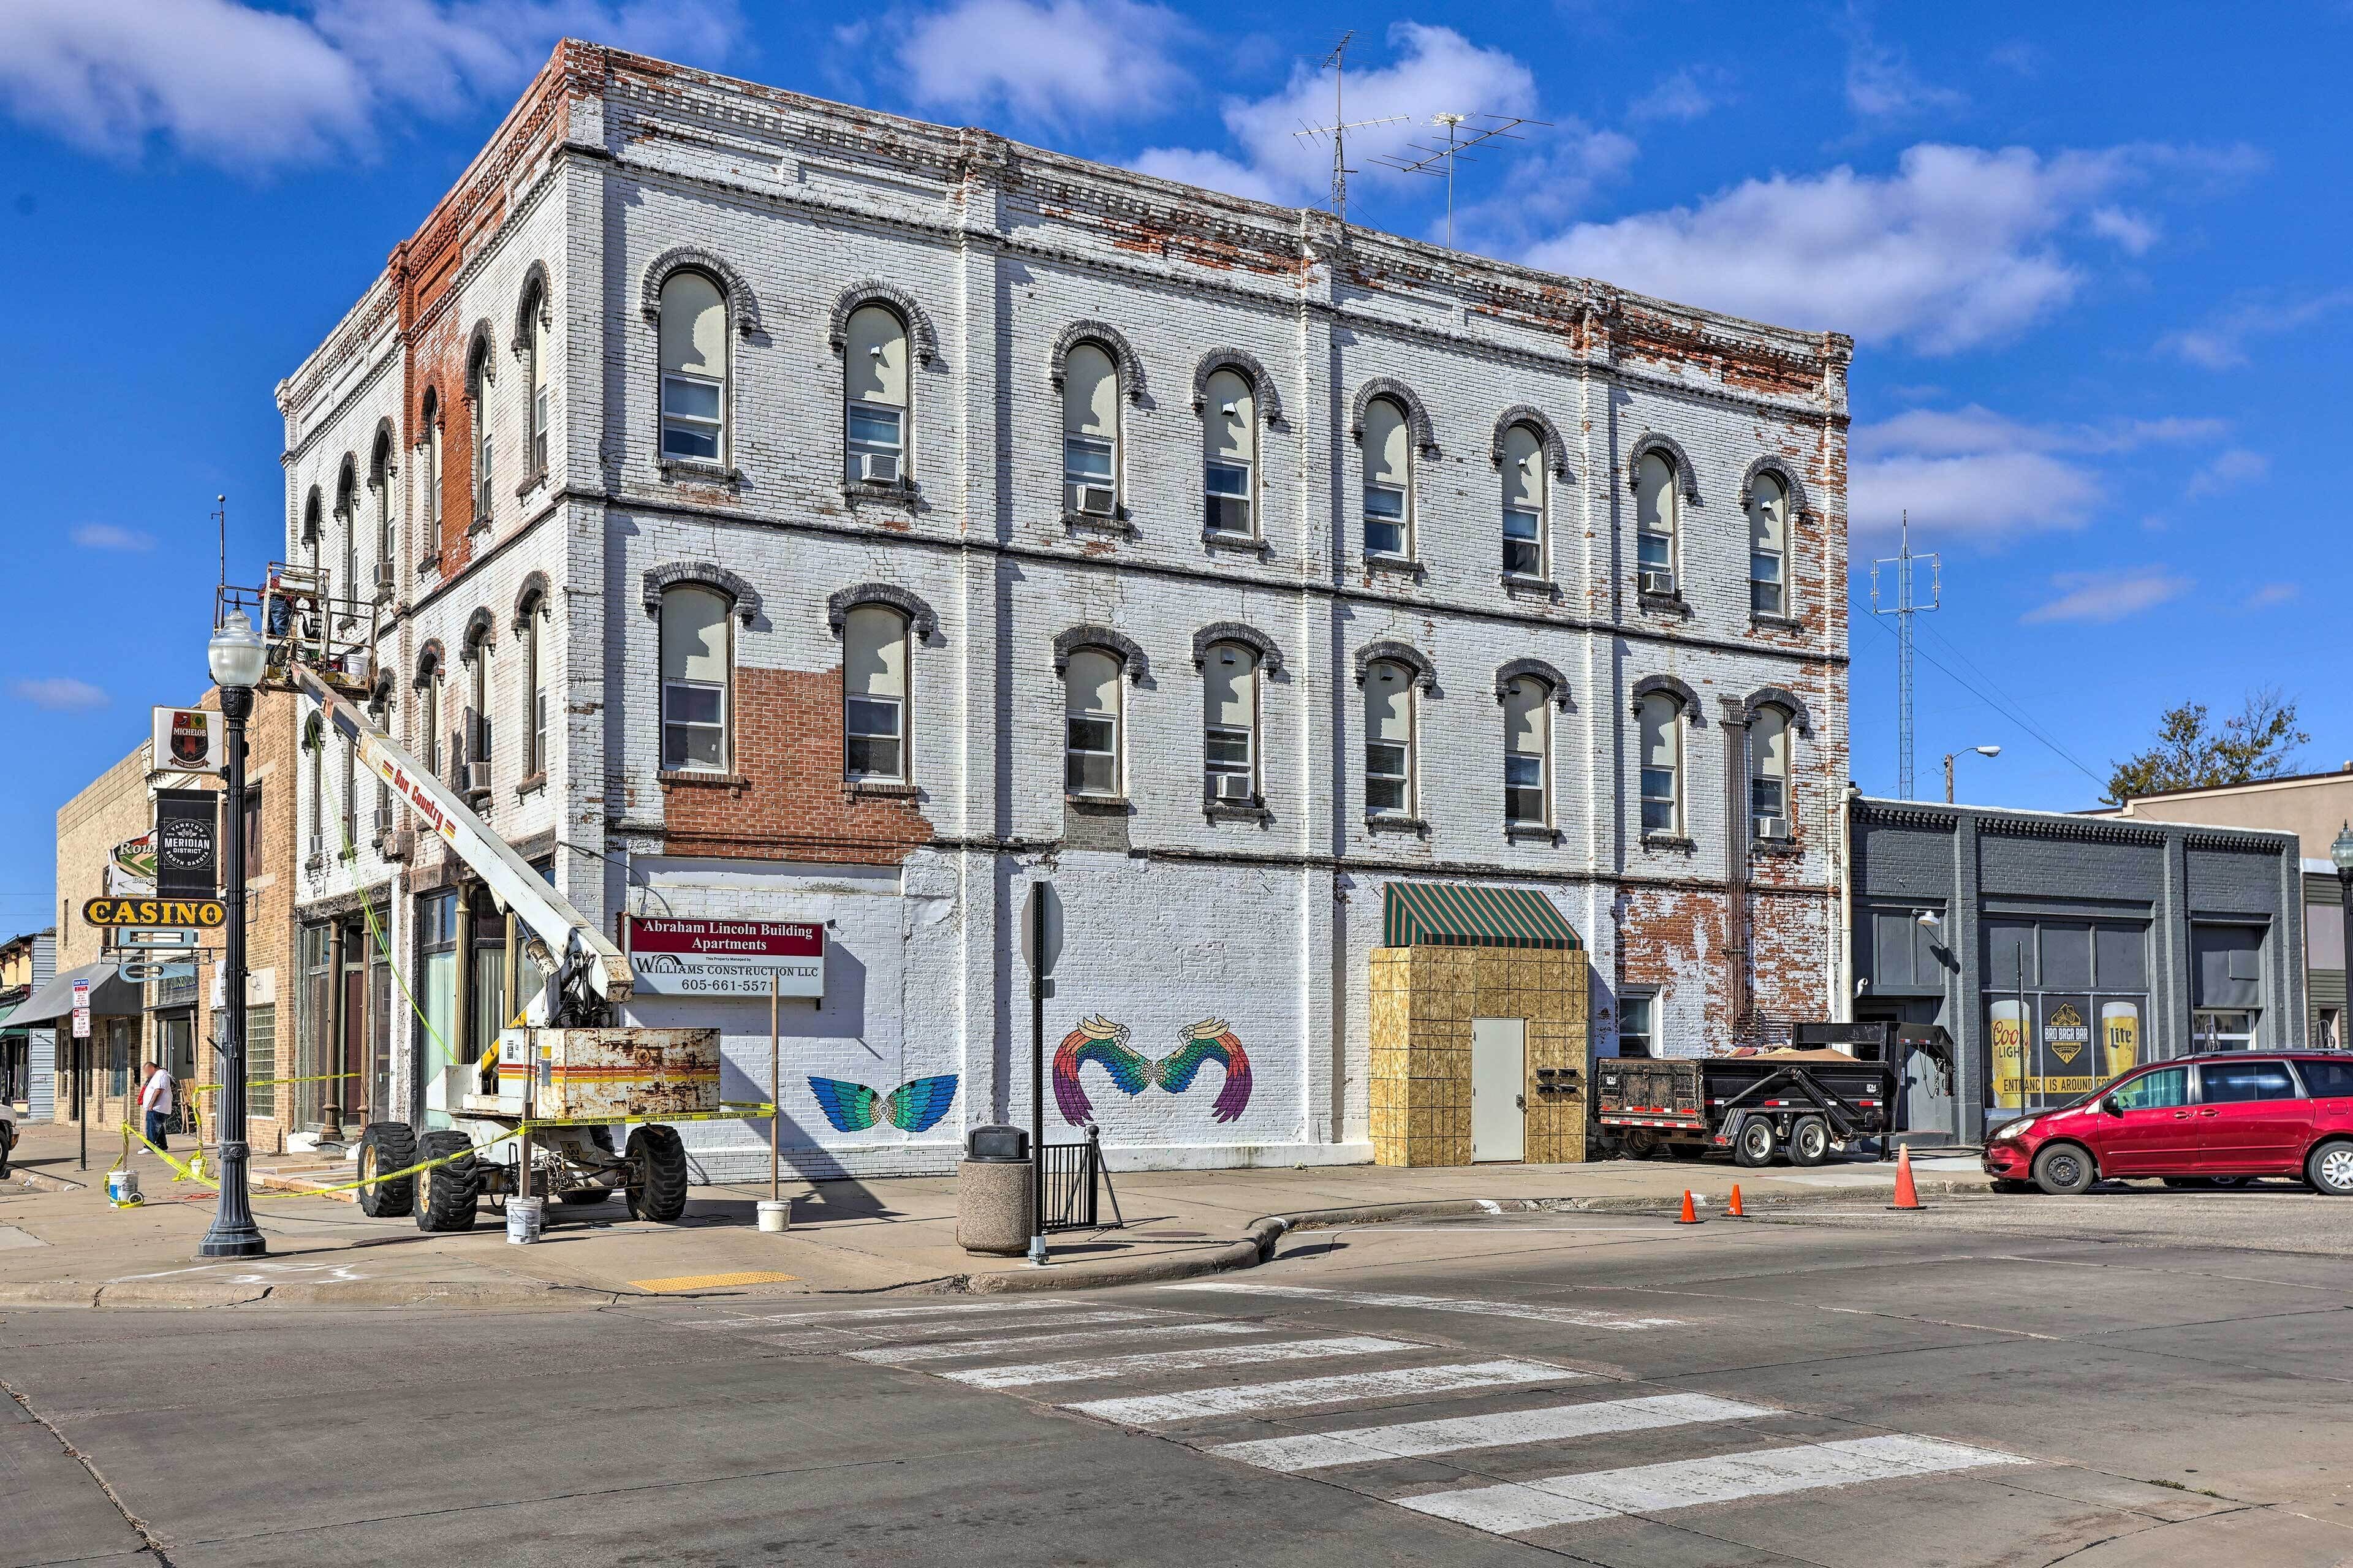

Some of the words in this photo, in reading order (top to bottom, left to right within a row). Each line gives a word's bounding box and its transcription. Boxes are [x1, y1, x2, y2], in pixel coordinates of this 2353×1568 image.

[395, 769, 409, 794] Sun
[411, 786, 444, 831] Country
[171, 823, 203, 833] YANKTON
[164, 838, 210, 850] MERIDIAN
[166, 850, 184, 865] SOUTH
[187, 852, 209, 866] DAKOTA
[88, 901, 223, 925] CASINO
[643, 920, 705, 933] Abraham
[709, 923, 757, 935] Lincoln
[761, 924, 813, 939] Building
[692, 937, 767, 951] Apartments
[635, 954, 704, 974] WILLIAMS
[708, 966, 794, 976] CONSTRUCTION
[798, 968, 818, 977] LLC
[682, 979, 773, 992] 605-661-5571
[1991, 1021, 2029, 1046] Coos
[2045, 1028, 2058, 1040] BRO
[2059, 1028, 2074, 1040] BRGR
[2075, 1028, 2088, 1040] BAR
[2110, 1028, 2132, 1049] Lite
[1999, 1046, 2020, 1058] LIGH
[2004, 1079, 2045, 1091] ENTANC
[2049, 1079, 2057, 1091] IS
[2061, 1078, 2093, 1091] AROUND
